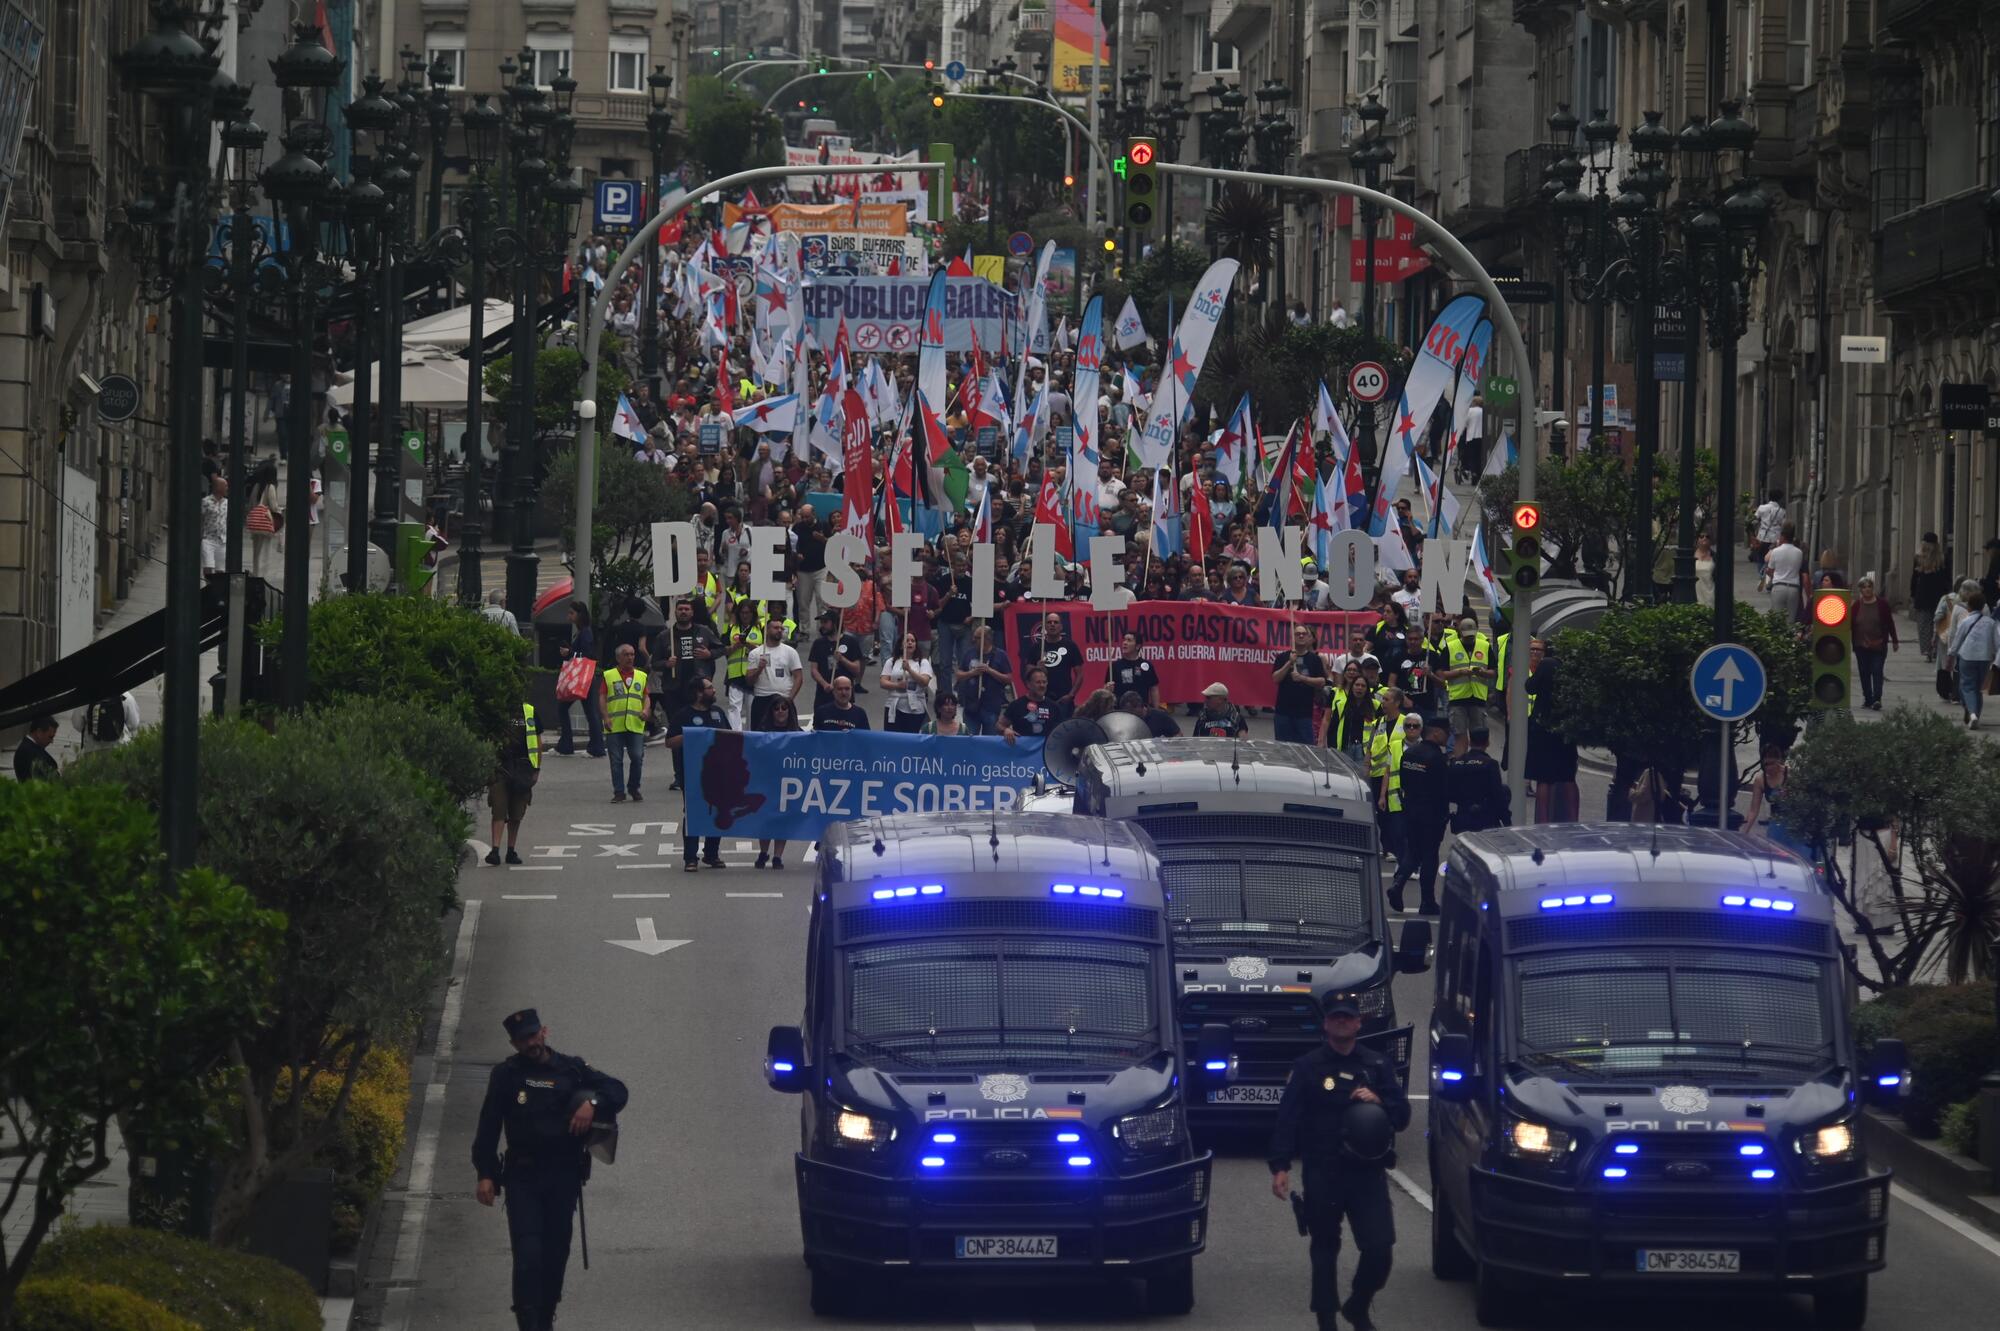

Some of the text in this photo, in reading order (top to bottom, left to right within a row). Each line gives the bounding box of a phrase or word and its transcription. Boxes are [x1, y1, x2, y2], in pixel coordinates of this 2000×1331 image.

[607, 187, 627, 211] P
[1355, 256, 1393, 267] arnal
[1194, 292, 1222, 323] bng
[1357, 374, 1380, 388] 40
[1944, 402, 1985, 411] SEPHORA
[651, 521, 1468, 618] DESFILE NON
[1085, 613, 1128, 643] NON
[1136, 615, 1175, 644] AOS
[1181, 613, 1260, 644] GASTOS
[1086, 646, 1122, 663] GALIZA
[1139, 645, 1166, 662] NTRA
[1168, 645, 1176, 660] A
[1178, 644, 1215, 661] GUERRA
[782, 752, 806, 769] nin
[811, 755, 867, 775] guerra,
[872, 756, 896, 773] nin
[901, 756, 947, 777] OTAN,
[952, 759, 977, 777] nin
[981, 761, 1034, 782] gastos
[779, 777, 851, 815] PAZ
[861, 781, 884, 816] E
[567, 822, 678, 835] US
[925, 1108, 1049, 1122] POLICIA
[966, 1238, 1055, 1255] CNP3844AZ
[1648, 1252, 1738, 1270] CNP3845AZ
